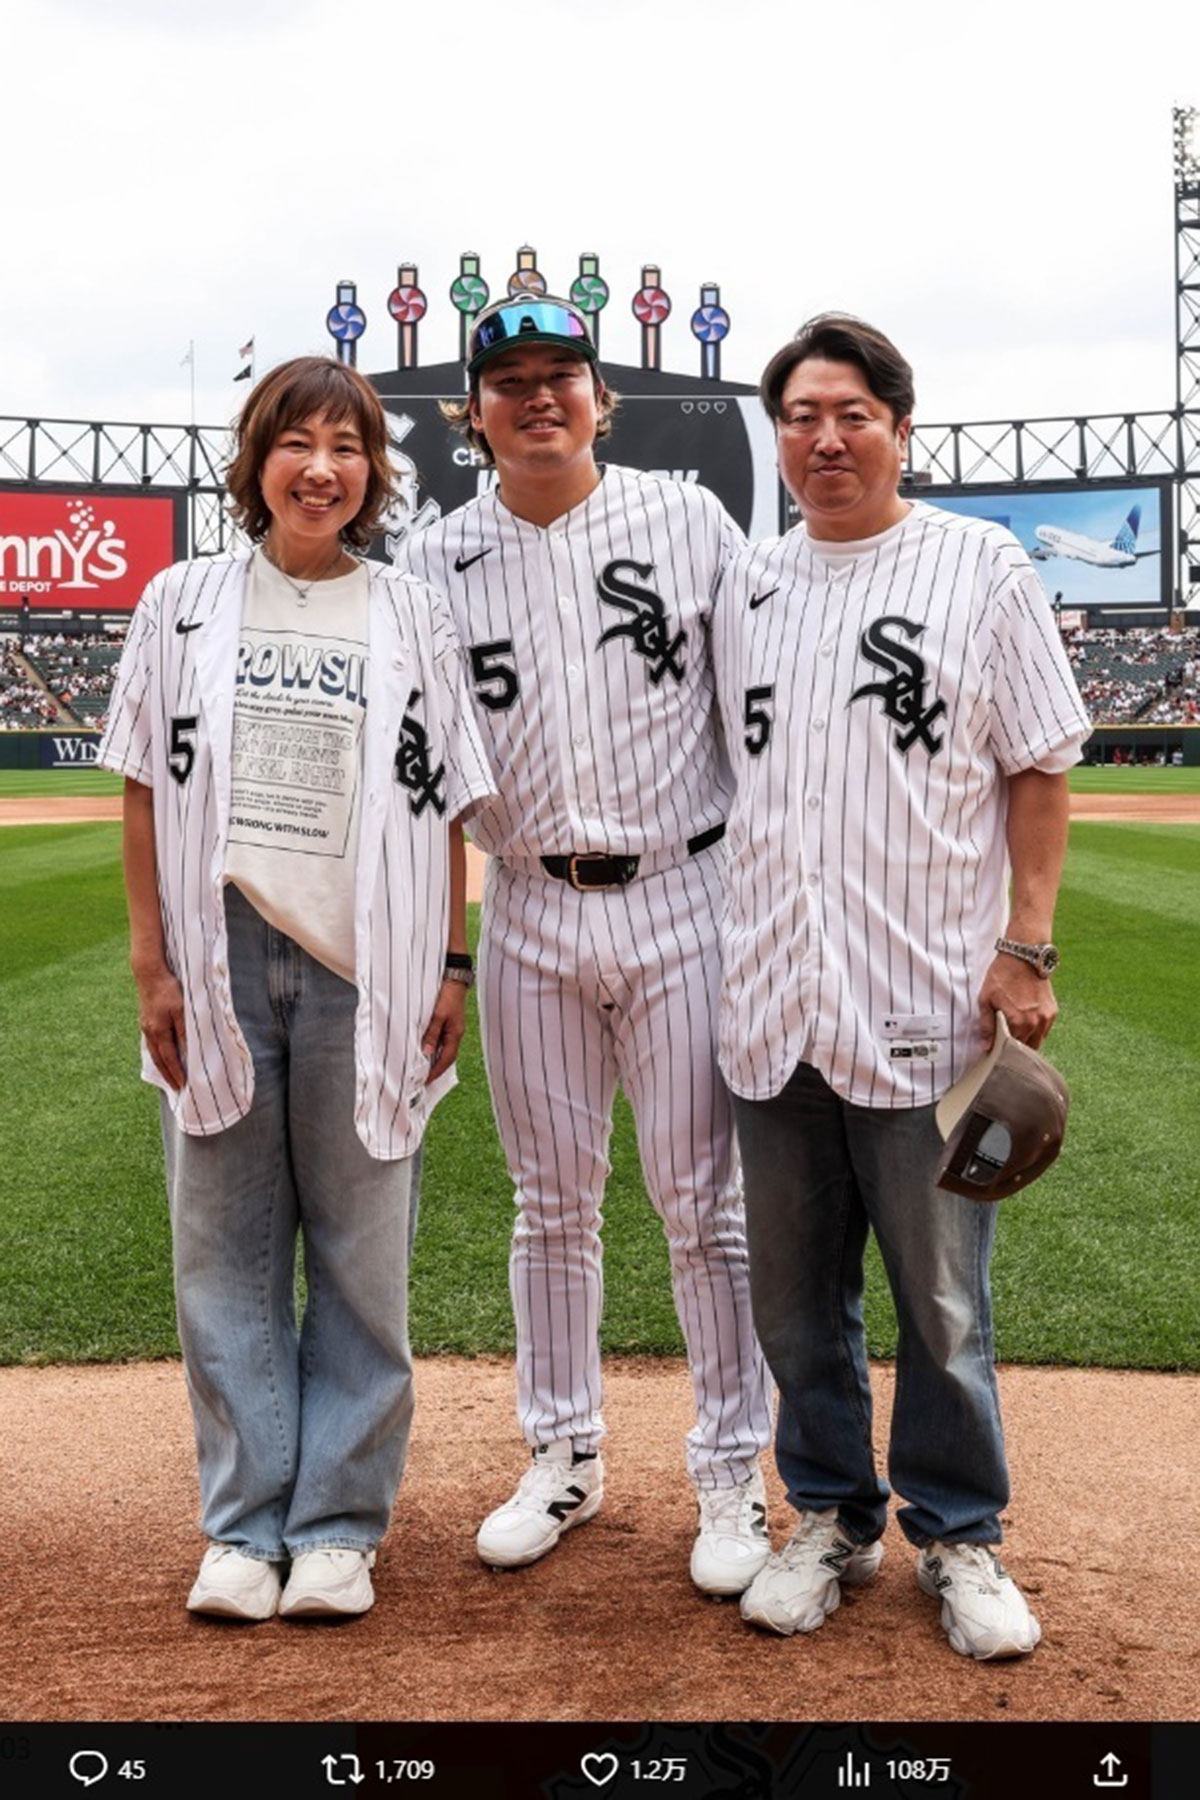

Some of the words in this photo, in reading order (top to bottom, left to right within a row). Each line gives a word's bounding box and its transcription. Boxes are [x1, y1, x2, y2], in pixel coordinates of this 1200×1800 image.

[9, 582, 52, 592] DEPOT
[470, 640, 520, 712] 5
[170, 716, 200, 785] 5
[743, 683, 776, 758] 5
[236, 817, 273, 831] WRONG
[274, 824, 300, 834] WITH
[301, 826, 329, 838] SLOW
